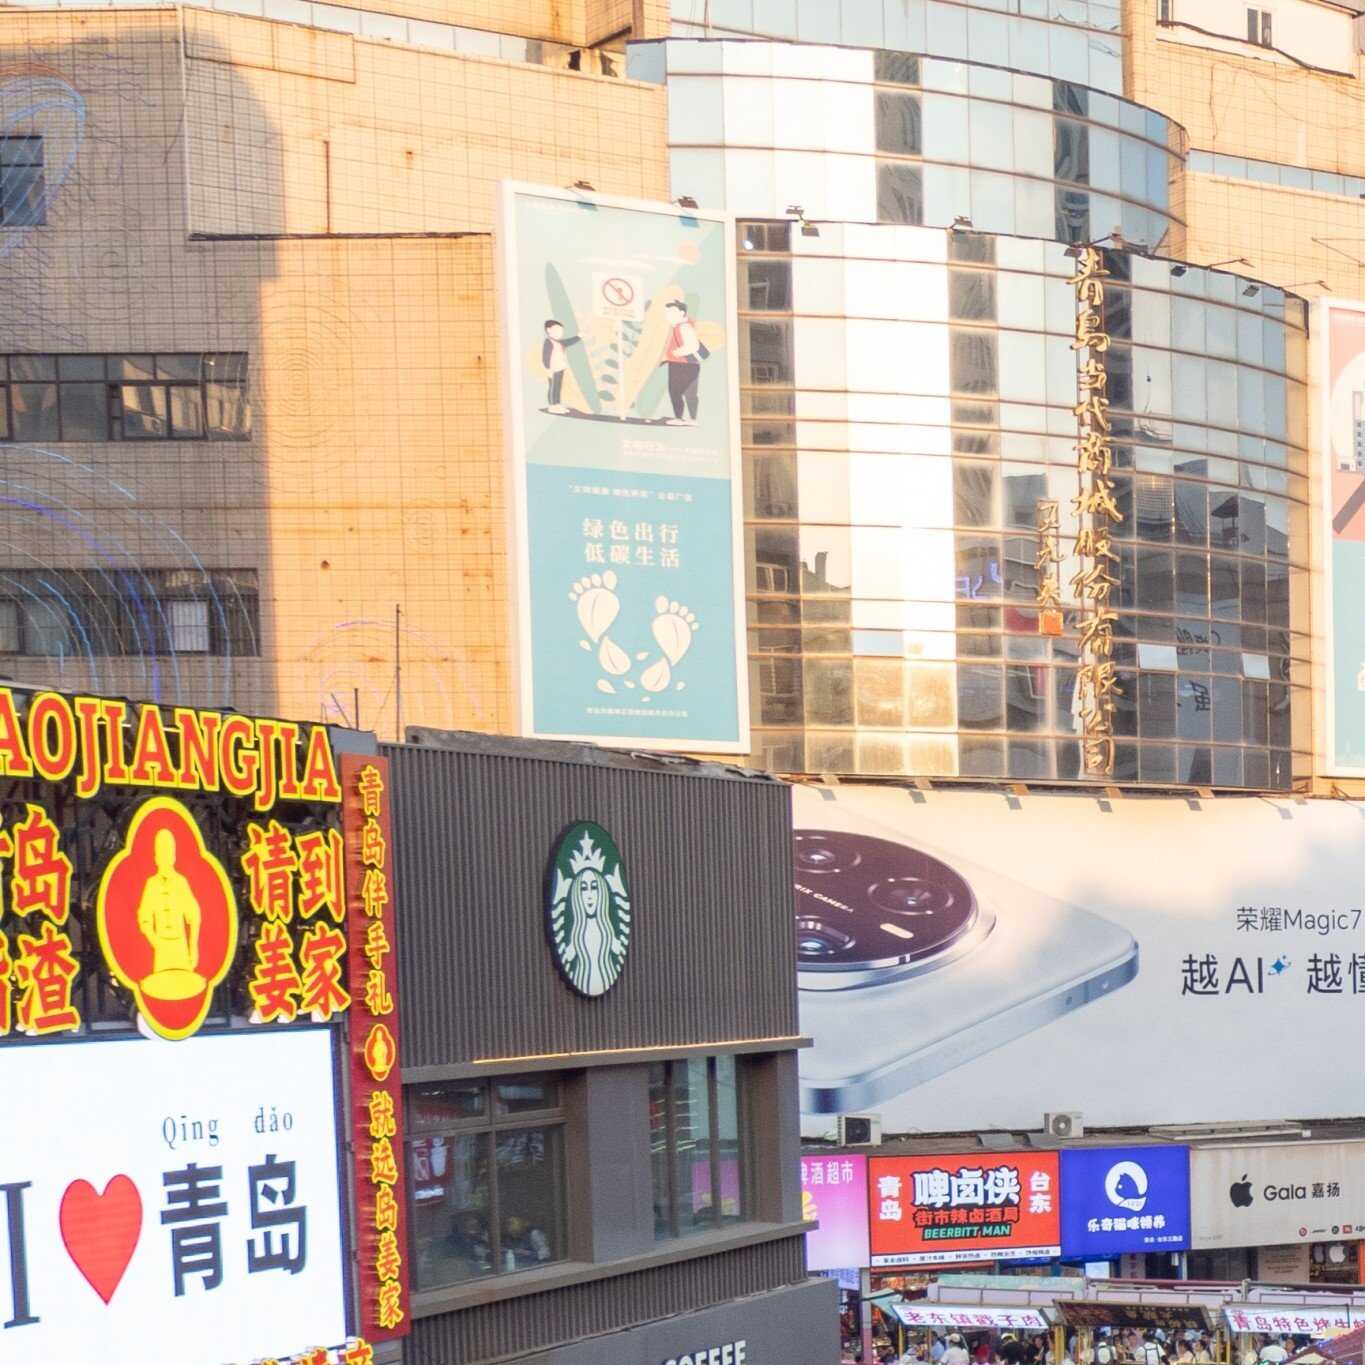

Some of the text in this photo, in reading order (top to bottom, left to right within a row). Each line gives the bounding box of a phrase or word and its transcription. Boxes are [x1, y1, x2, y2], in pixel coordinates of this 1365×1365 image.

[583, 517, 681, 543] 绿色出行
[584, 541, 682, 568] 低碳生活
[0, 803, 345, 926] 岛 请到
[358, 764, 394, 1016] 青岛伴手礼
[1236, 906, 1362, 935] 荣耀Magic7
[0, 920, 352, 1036] 渣 姜家
[368, 1089, 404, 1330] 就选岛姜家
[877, 1175, 902, 1222] 青岛
[911, 1166, 1020, 1208] 啤卤侠
[1030, 1170, 1052, 1214] 台东
[1263, 1181, 1341, 1202] Gala 嘉扬
[158, 1154, 309, 1302] 青岛
